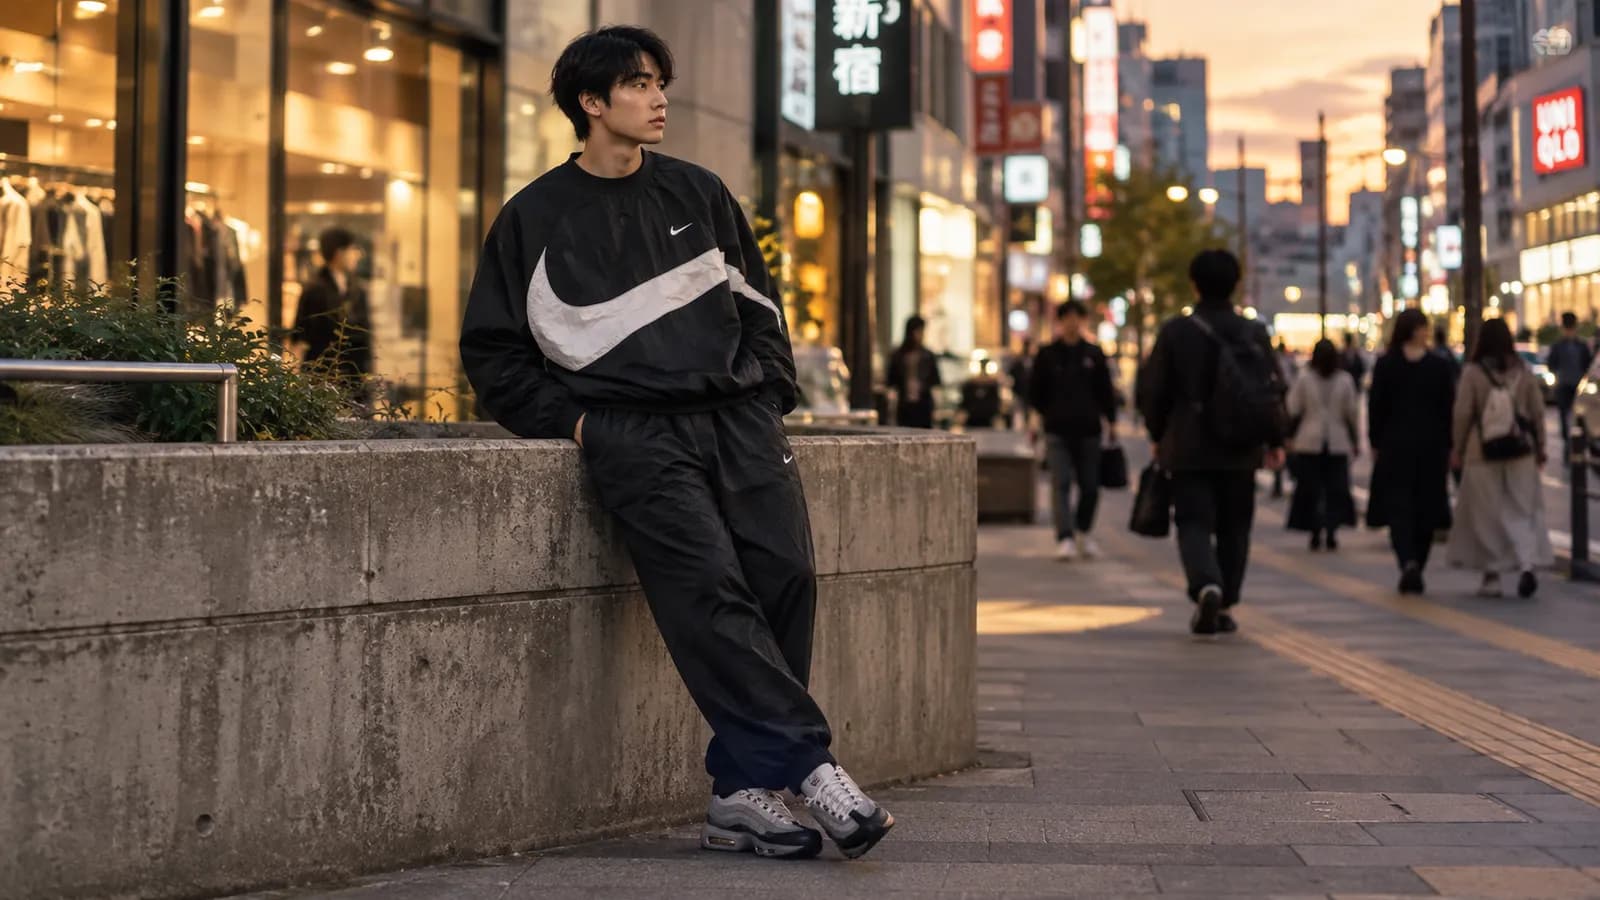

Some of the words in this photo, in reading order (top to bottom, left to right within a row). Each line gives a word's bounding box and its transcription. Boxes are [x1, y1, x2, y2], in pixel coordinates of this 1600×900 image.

[832, 0, 881, 95] 新宿
[1536, 96, 1576, 134] UNI
[1537, 129, 1579, 169] QLO
